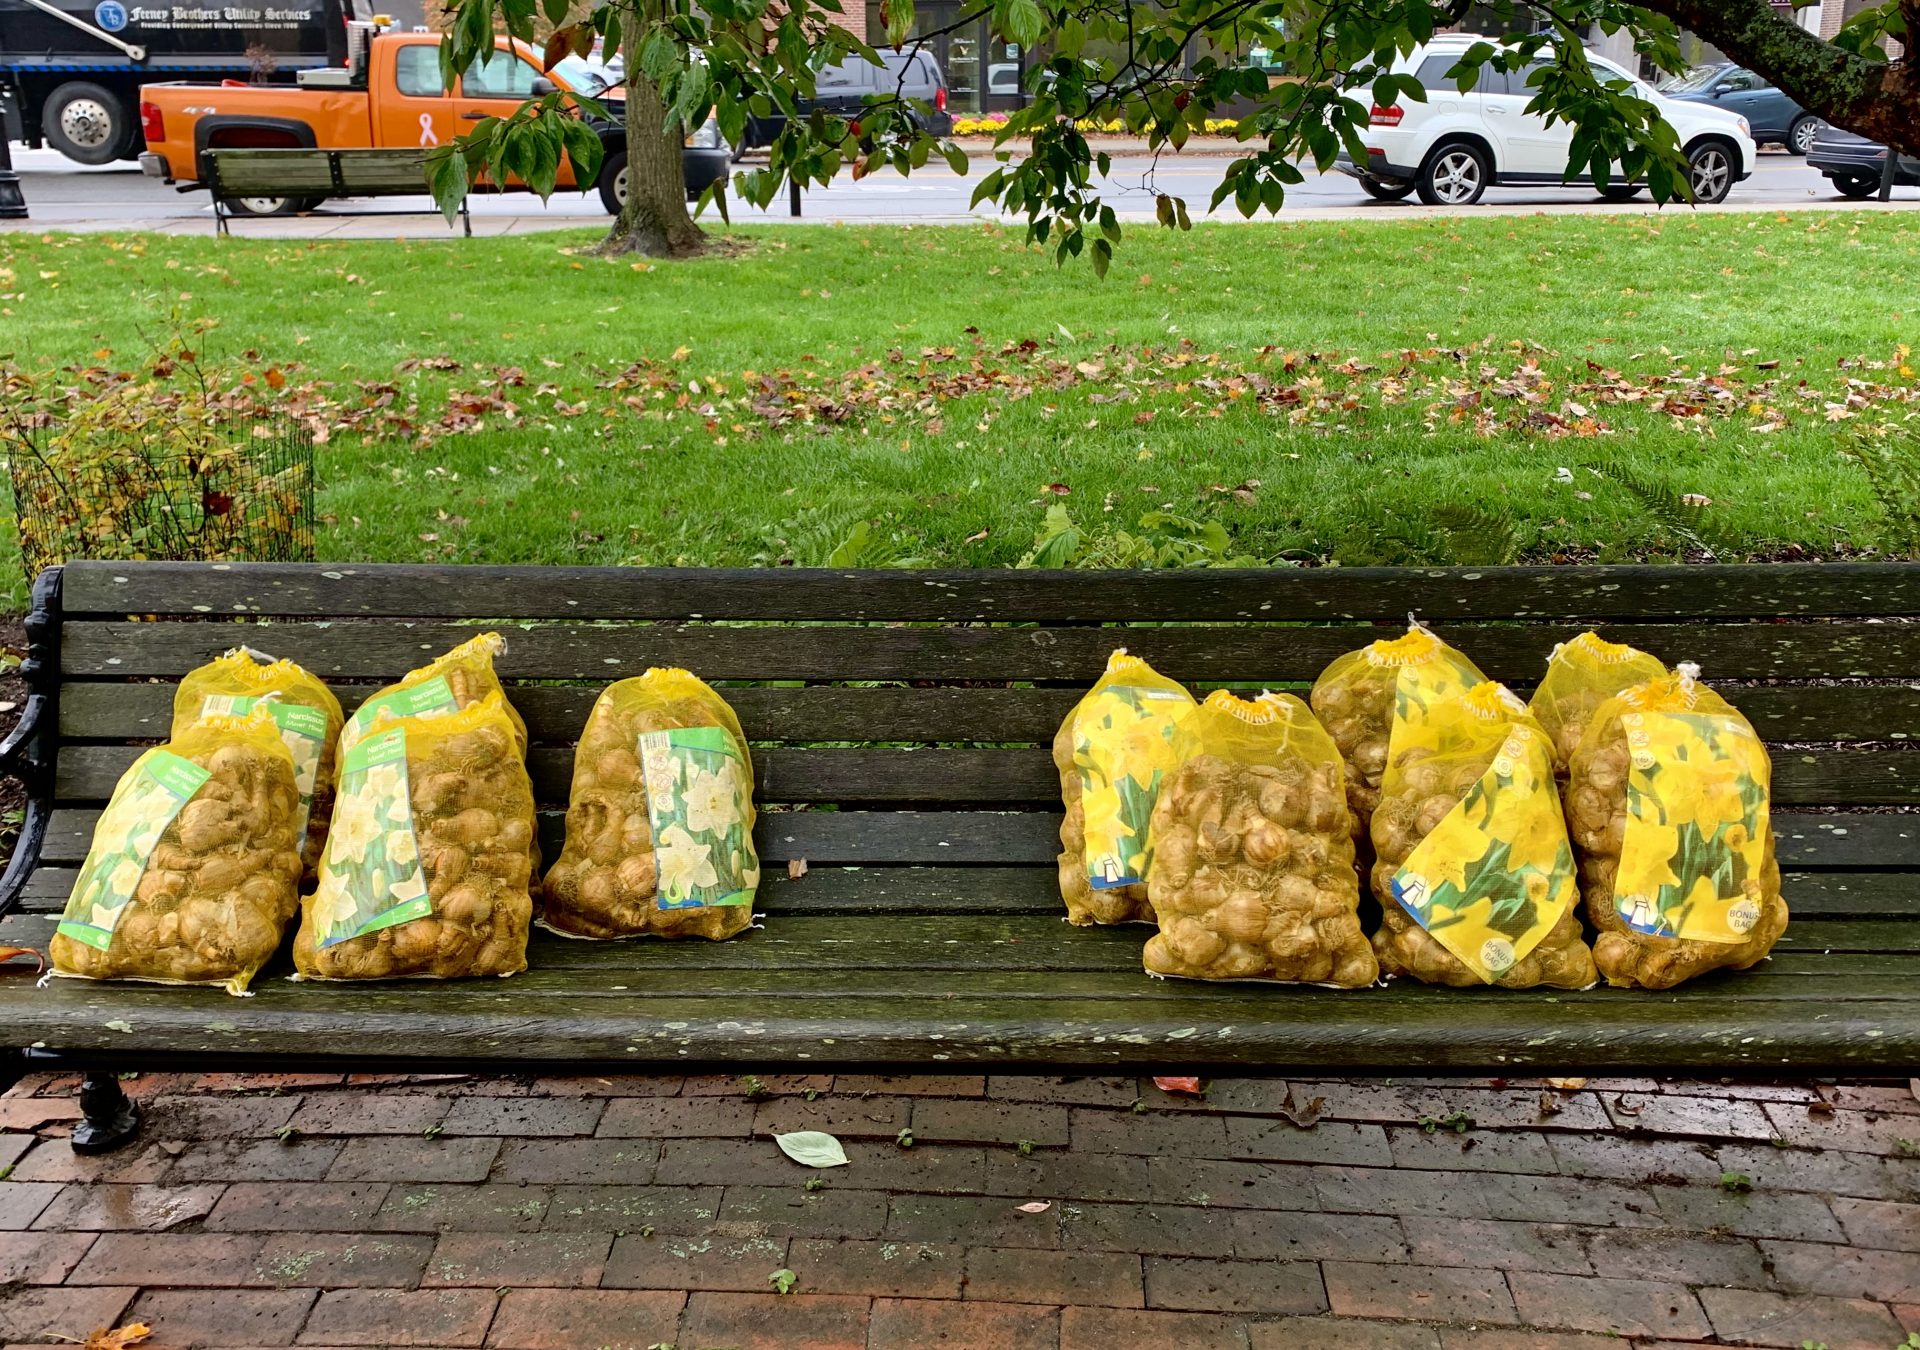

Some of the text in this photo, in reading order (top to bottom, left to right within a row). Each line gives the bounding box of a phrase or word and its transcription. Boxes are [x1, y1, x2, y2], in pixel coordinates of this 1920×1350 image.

[129, 6, 311, 22] Feeney Brothers Utility Services
[410, 684, 446, 702] Narcissus
[287, 711, 324, 725] Narcissus
[1729, 909, 1760, 920] BONUS
[1734, 919, 1752, 929] BAG
[1484, 951, 1500, 968] BAG
[1485, 940, 1512, 965] BONUS
